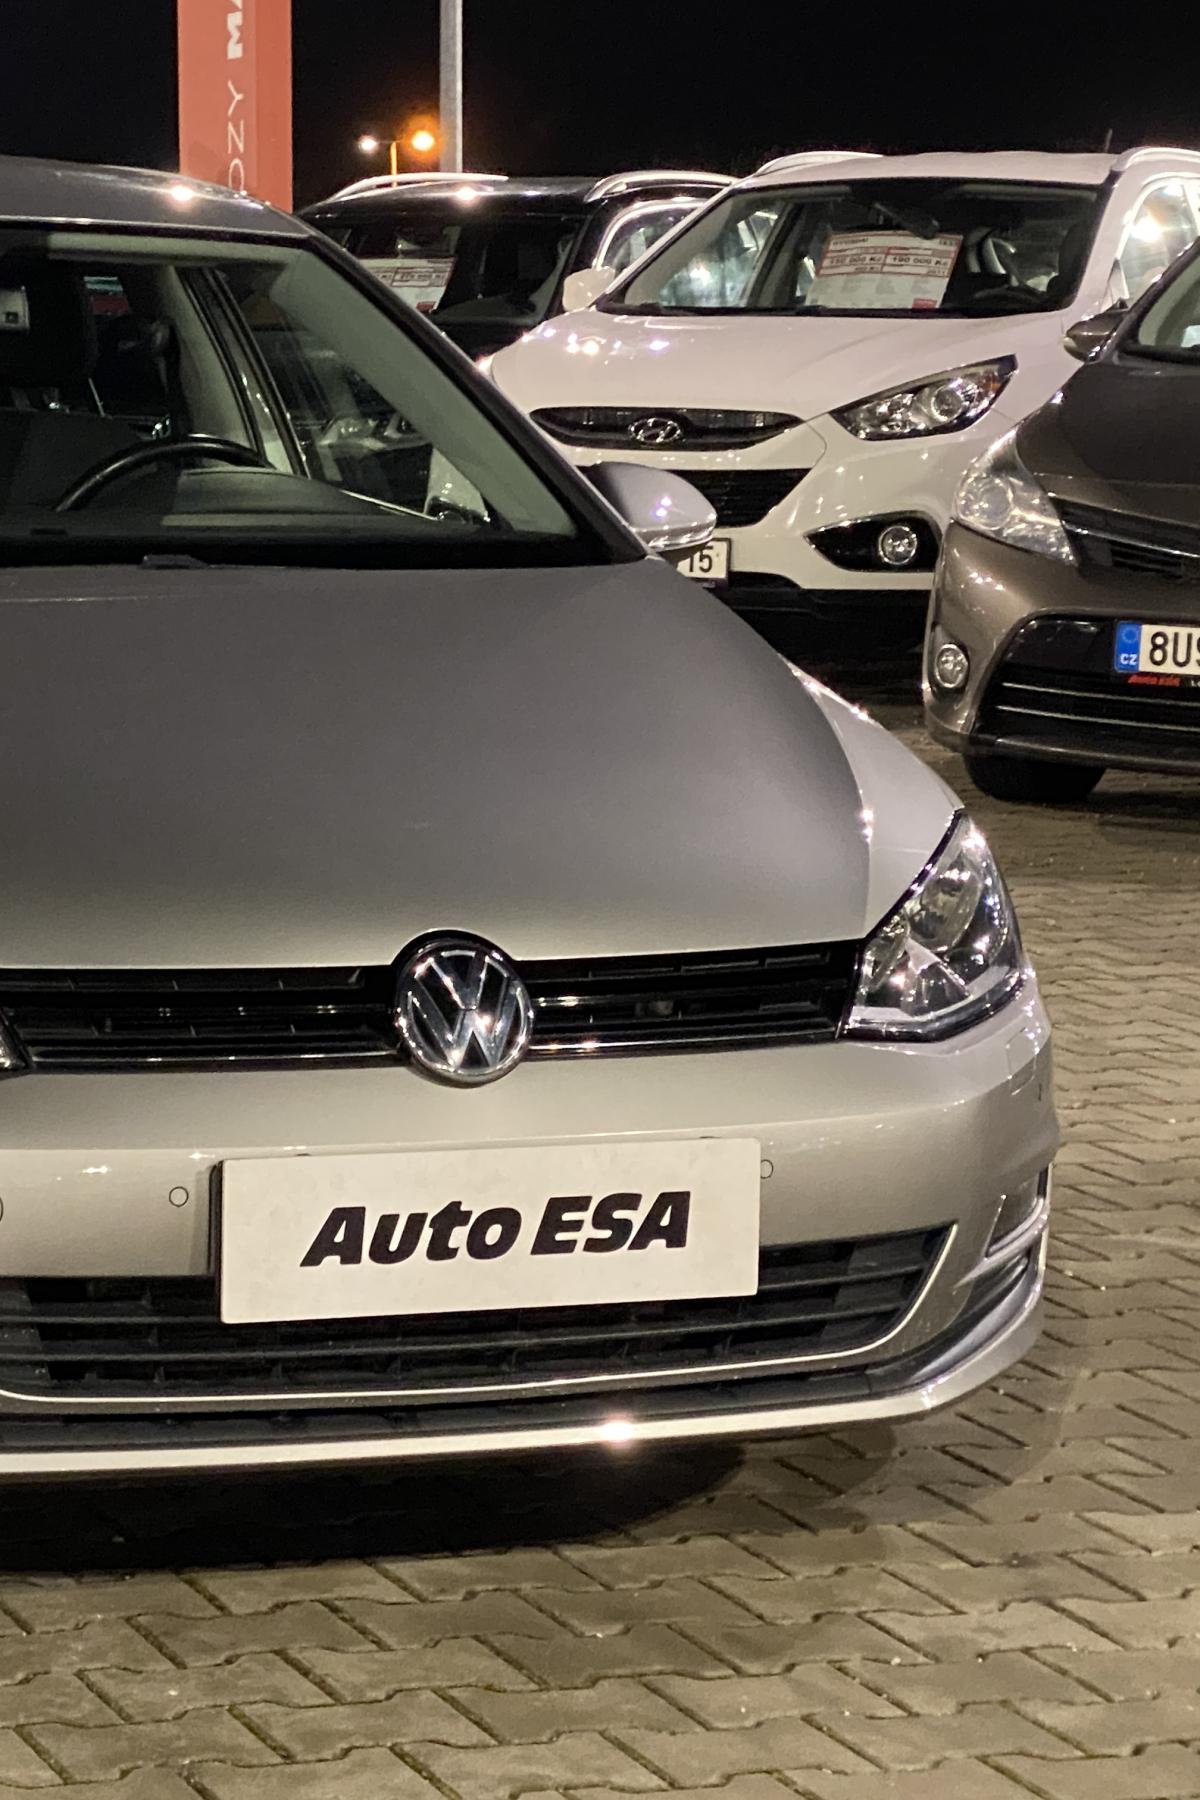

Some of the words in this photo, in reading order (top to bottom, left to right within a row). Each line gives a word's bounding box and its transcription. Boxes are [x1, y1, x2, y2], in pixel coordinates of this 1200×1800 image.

[226, 0, 243, 60] M
[1120, 653, 1138, 666] CZ
[1149, 631, 1200, 667] 8U
[299, 1200, 523, 1268] Auto
[529, 1190, 692, 1256] ESA
